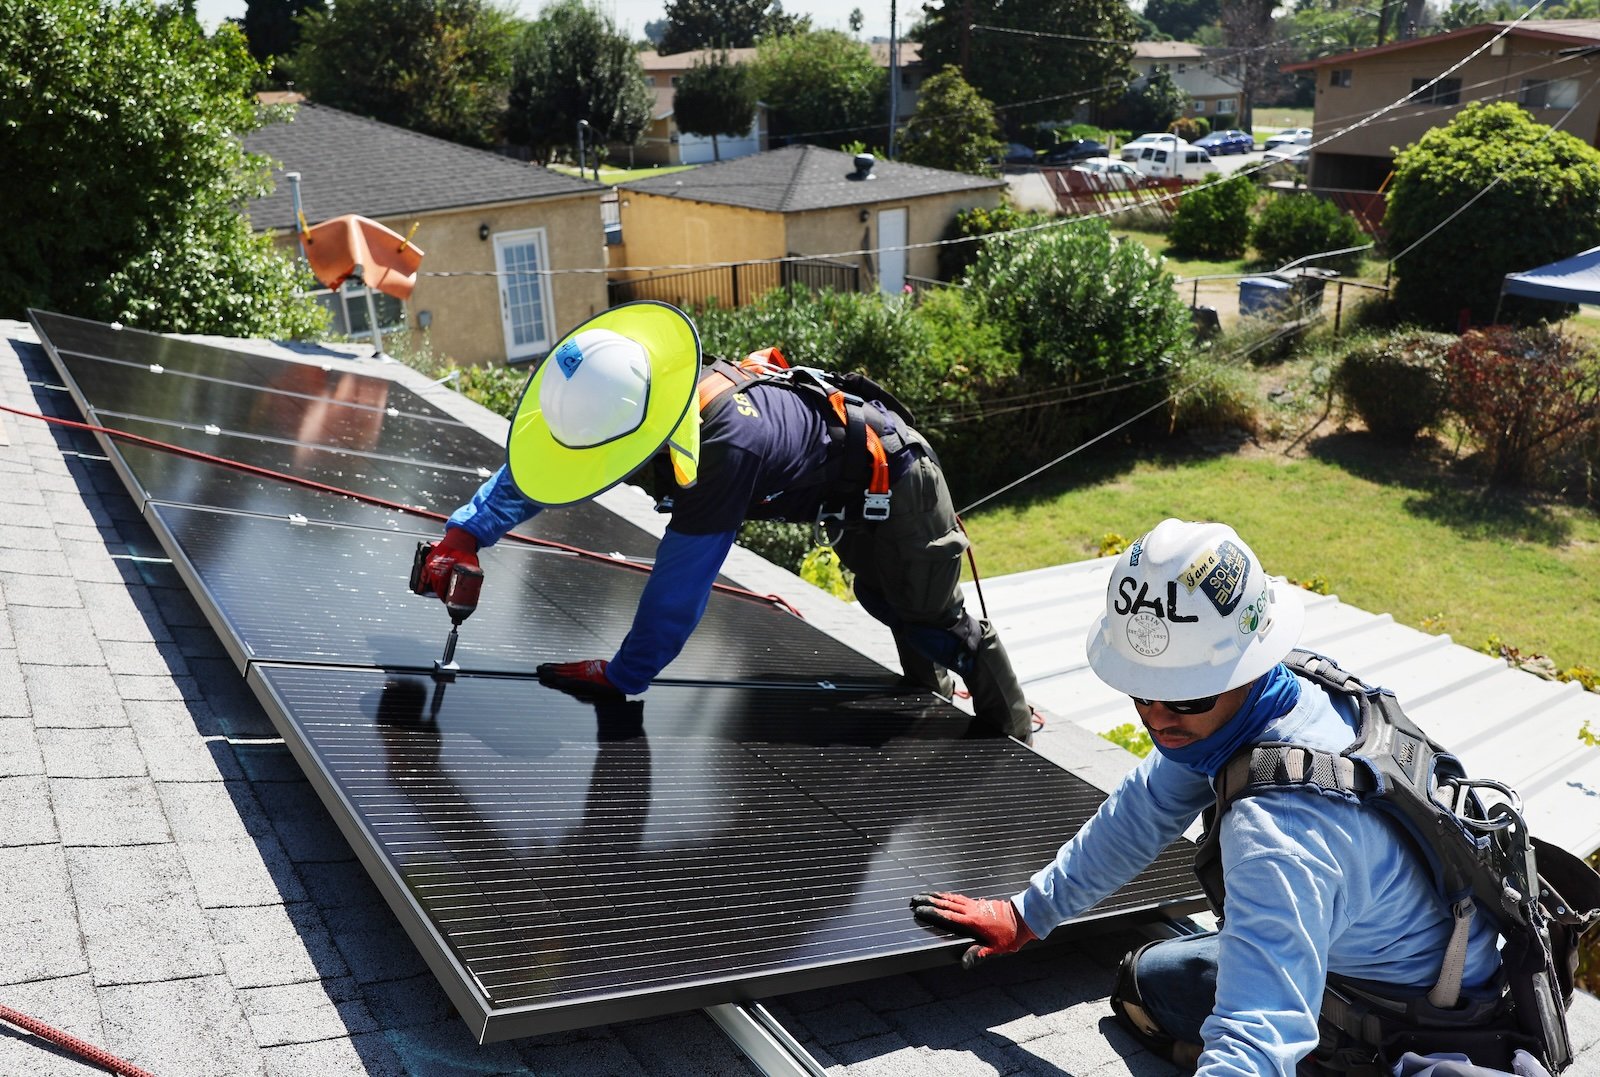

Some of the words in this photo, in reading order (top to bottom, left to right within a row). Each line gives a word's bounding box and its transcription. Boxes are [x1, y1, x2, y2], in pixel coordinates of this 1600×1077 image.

[1195, 563, 1209, 580] am
[1208, 555, 1216, 565] a
[1209, 554, 1235, 589] SOLAR
[1215, 552, 1246, 605] BUILDER
[1134, 615, 1160, 626] KLEIN
[1134, 643, 1160, 655] TOOLS
